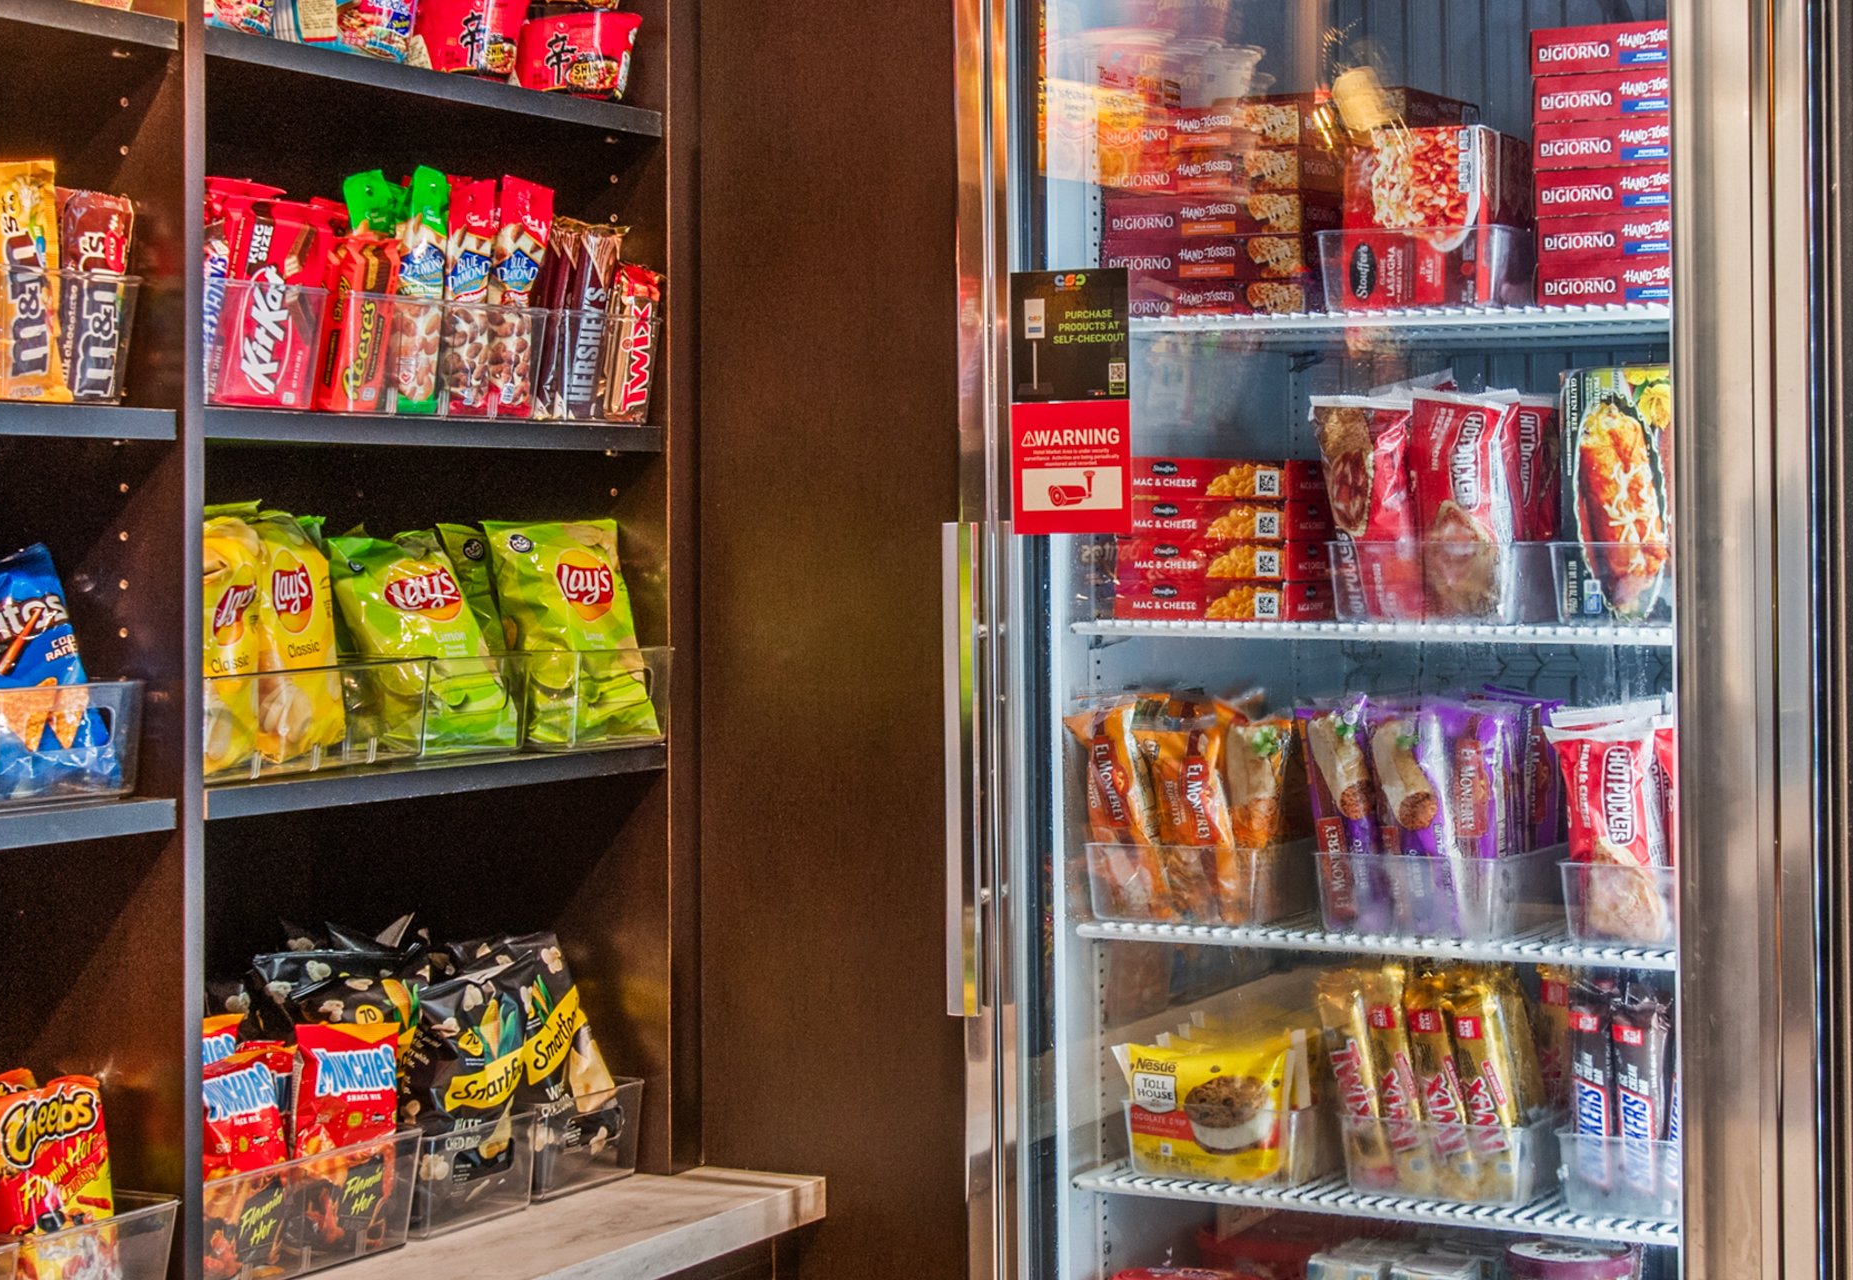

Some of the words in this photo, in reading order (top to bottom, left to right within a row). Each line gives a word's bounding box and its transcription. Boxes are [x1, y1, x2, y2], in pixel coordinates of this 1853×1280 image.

[573, 62, 601, 75] SHIN
[248, 224, 264, 264] KING
[258, 223, 274, 263] SIZE
[457, 253, 479, 270] BLUE
[1386, 245, 1397, 297] LASAGNA
[448, 264, 492, 288] DIAMOND
[1058, 321, 1105, 332] PRODUCTS
[1107, 321, 1120, 330] AT
[1065, 309, 1113, 320] PURCHASE
[342, 300, 377, 401] Reese's
[568, 286, 607, 402] HERSHEY'S
[1053, 332, 1125, 345] SELF-CHECKOUT
[621, 302, 652, 413] TWIX
[1570, 377, 1578, 408] GLUTEN
[1034, 427, 1120, 447] WARNING
[1133, 478, 1153, 488] MAC
[1154, 478, 1162, 488] &
[1163, 478, 1197, 488] CHEESE
[273, 566, 312, 616] Lay's
[557, 561, 613, 606] Lay's
[288, 638, 321, 659] Classic
[1092, 740, 1111, 763] EL
[1097, 762, 1126, 826] MONTEREY
[360, 1008, 376, 1022] 70
[316, 1044, 397, 1097] MUNCHIES
[1135, 1057, 1177, 1073] Nestlé
[1136, 1088, 1174, 1101] HOUSE
[1142, 1077, 1168, 1090] TOLL
[0, 1089, 98, 1167] Cheetos
[351, 1191, 376, 1215] Hot
